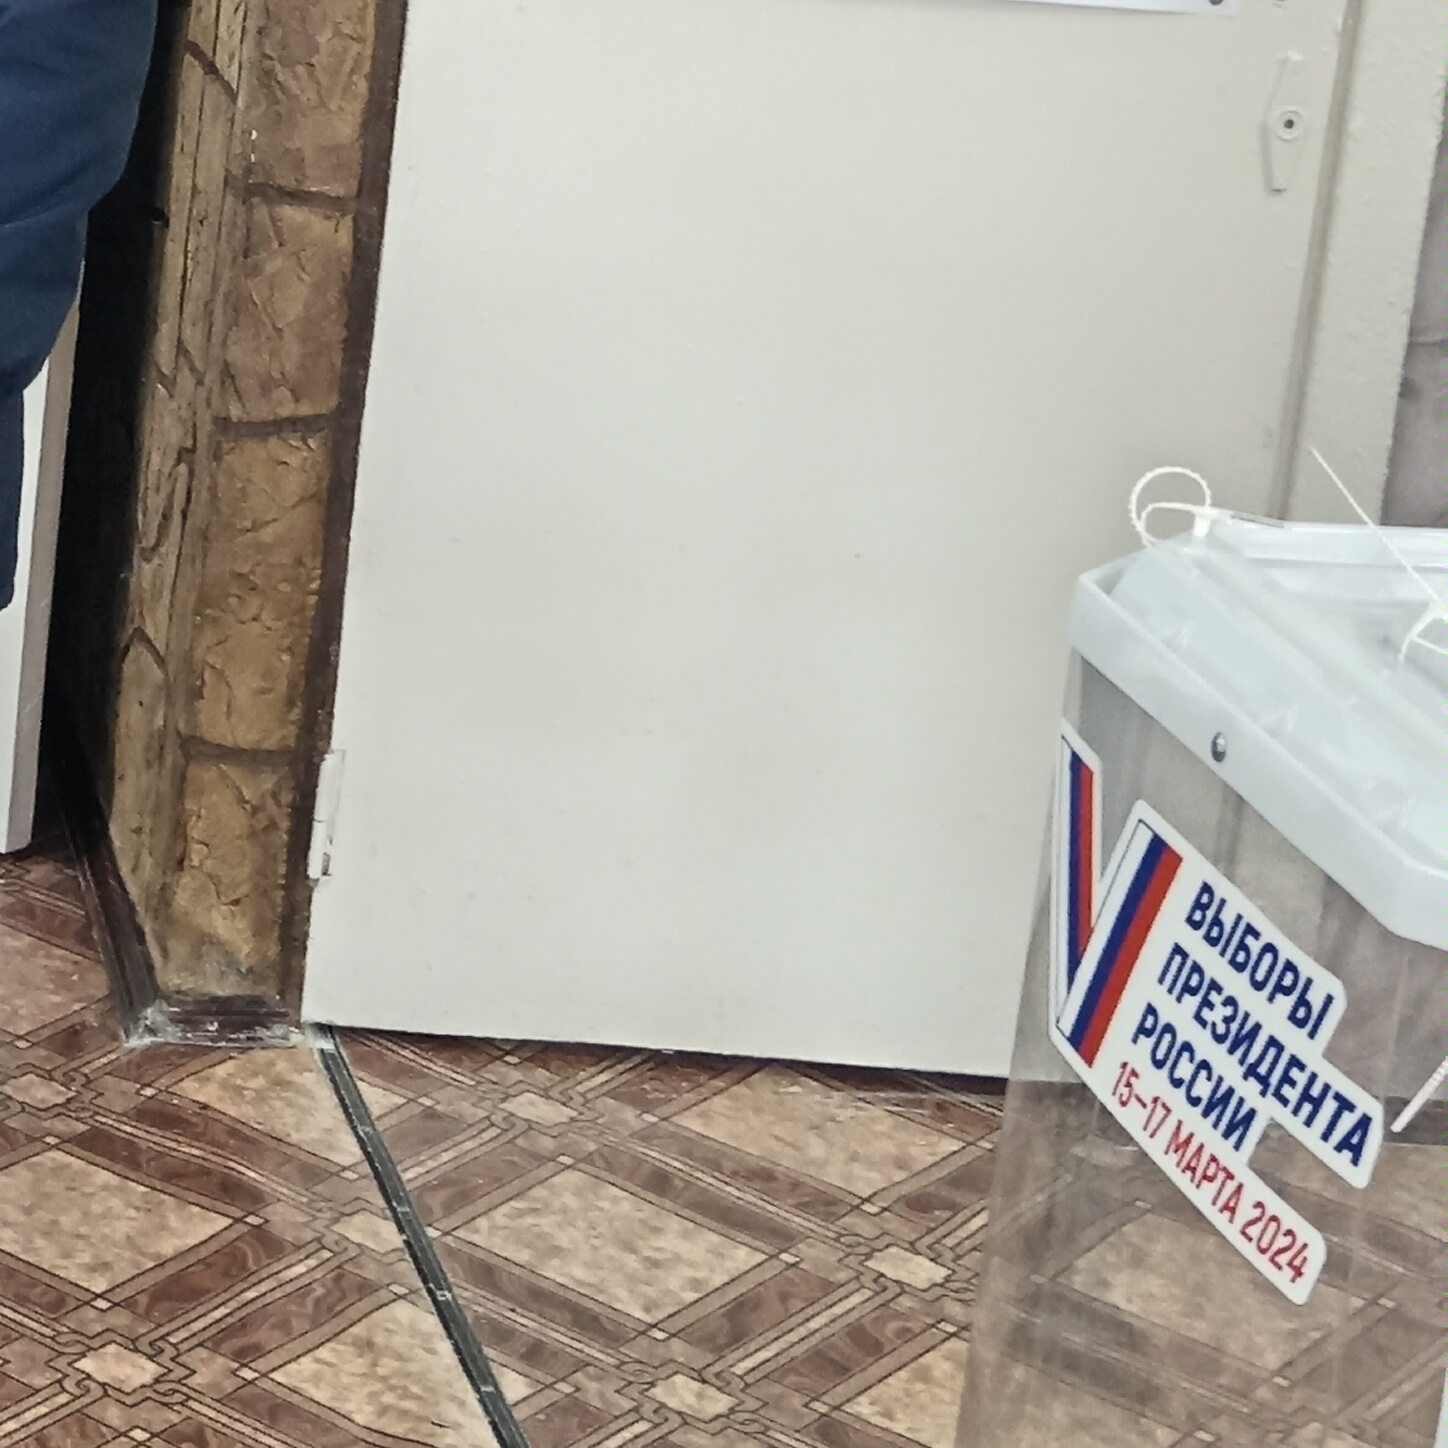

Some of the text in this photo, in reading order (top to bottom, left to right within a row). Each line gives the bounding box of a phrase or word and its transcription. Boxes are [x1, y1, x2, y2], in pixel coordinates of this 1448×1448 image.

[1185, 880, 1335, 1042] ВЫБОРЫ
[1131, 1002, 1257, 1152] РОССИИ
[1157, 942, 1373, 1168] ПРЕЗИДЕНТА
[1164, 1120, 1244, 1232] МАРТА
[1240, 1201, 1310, 1285] 2024
